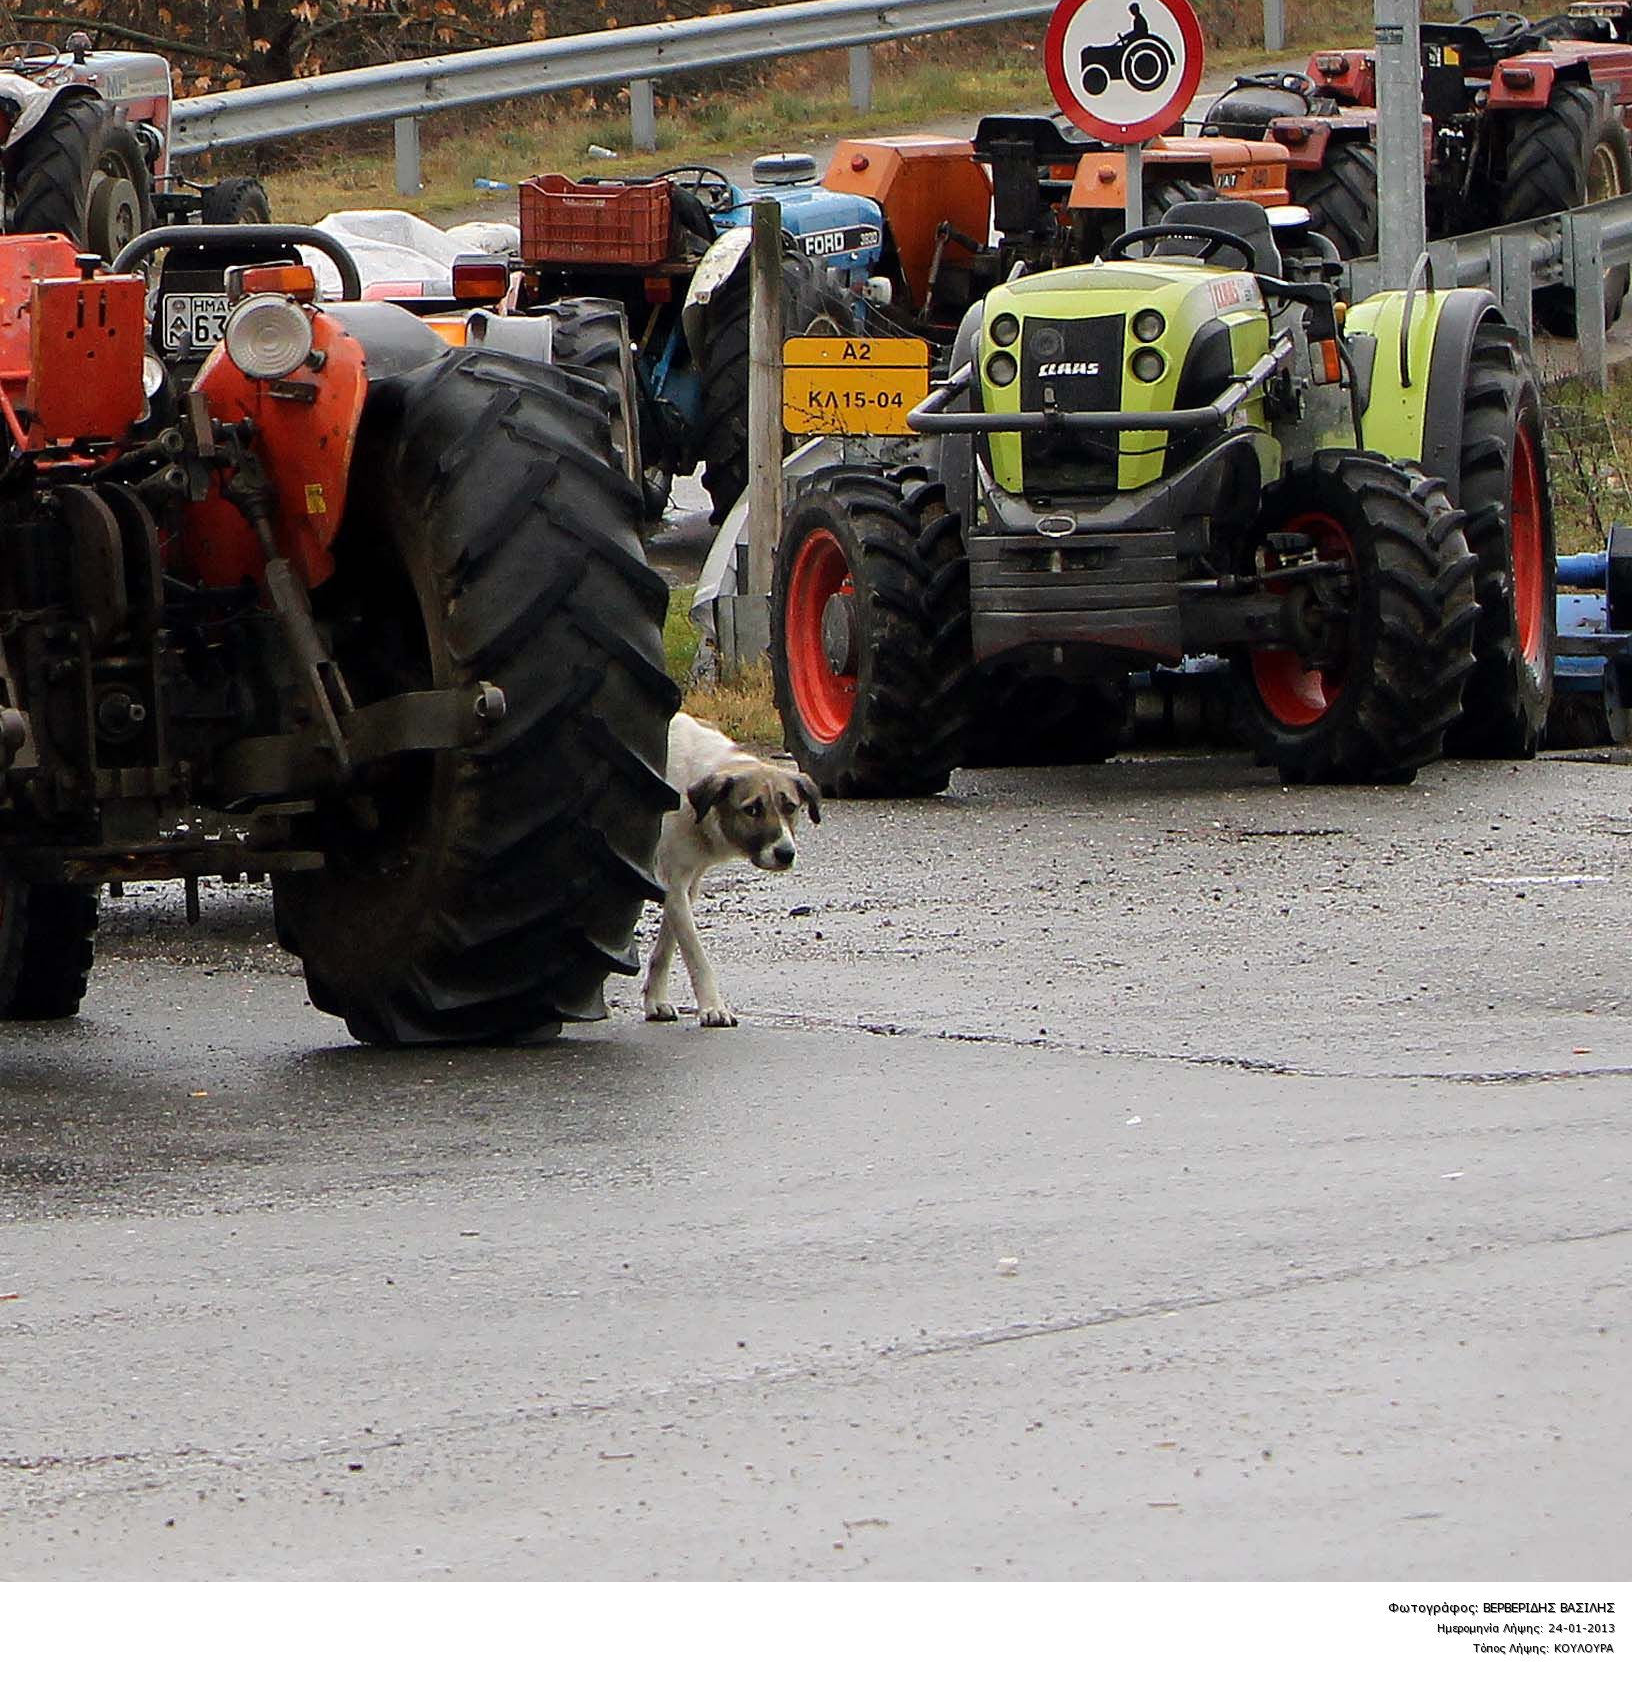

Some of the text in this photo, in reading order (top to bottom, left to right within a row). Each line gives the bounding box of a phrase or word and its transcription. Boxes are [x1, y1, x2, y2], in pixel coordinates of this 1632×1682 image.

[805, 232, 845, 256] FORD
[842, 343, 872, 361] A2
[1038, 362, 1100, 377] CLAAS
